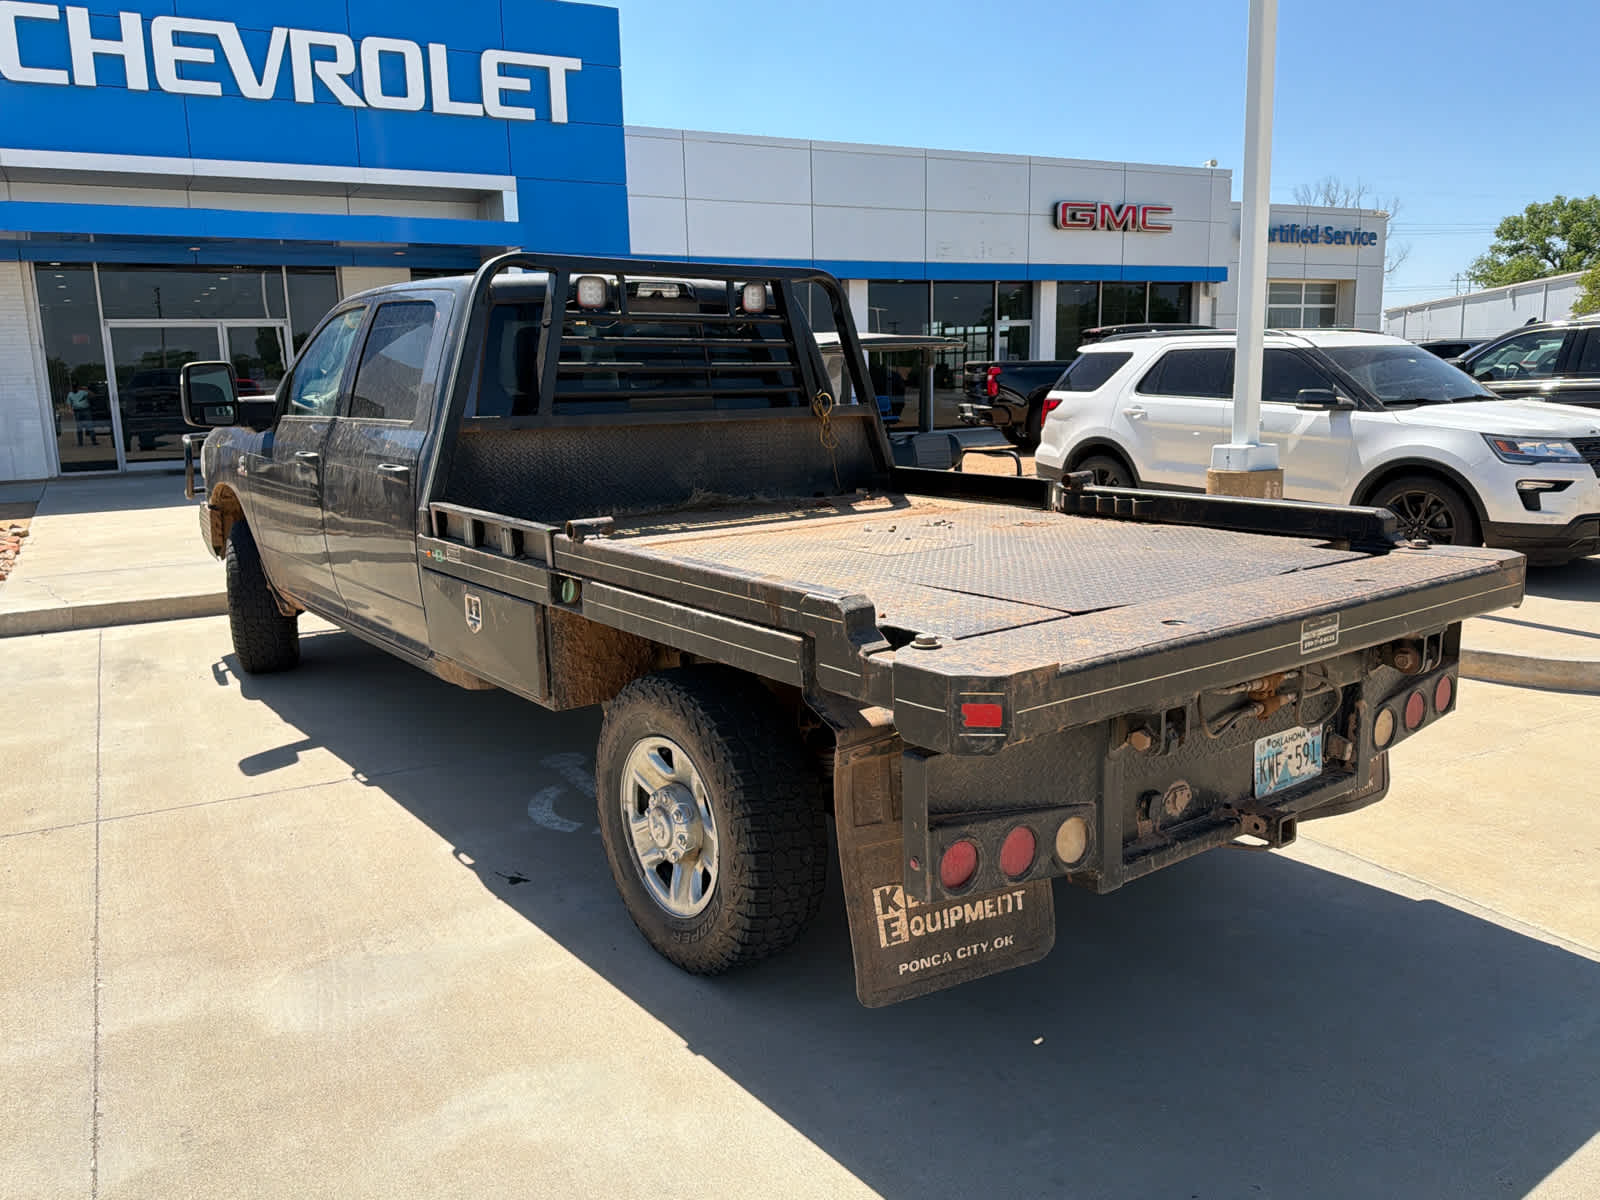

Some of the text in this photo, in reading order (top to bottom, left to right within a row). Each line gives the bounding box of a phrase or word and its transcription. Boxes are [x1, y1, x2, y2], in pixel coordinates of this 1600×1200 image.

[0, 0, 583, 123] CHEVROLET
[1056, 200, 1173, 232] GMC
[1269, 223, 1377, 246] rtified Service
[1271, 730, 1306, 749] OKLAHOMA
[876, 889, 1026, 949] EQUIPMENT
[899, 951, 953, 976] PONCA
